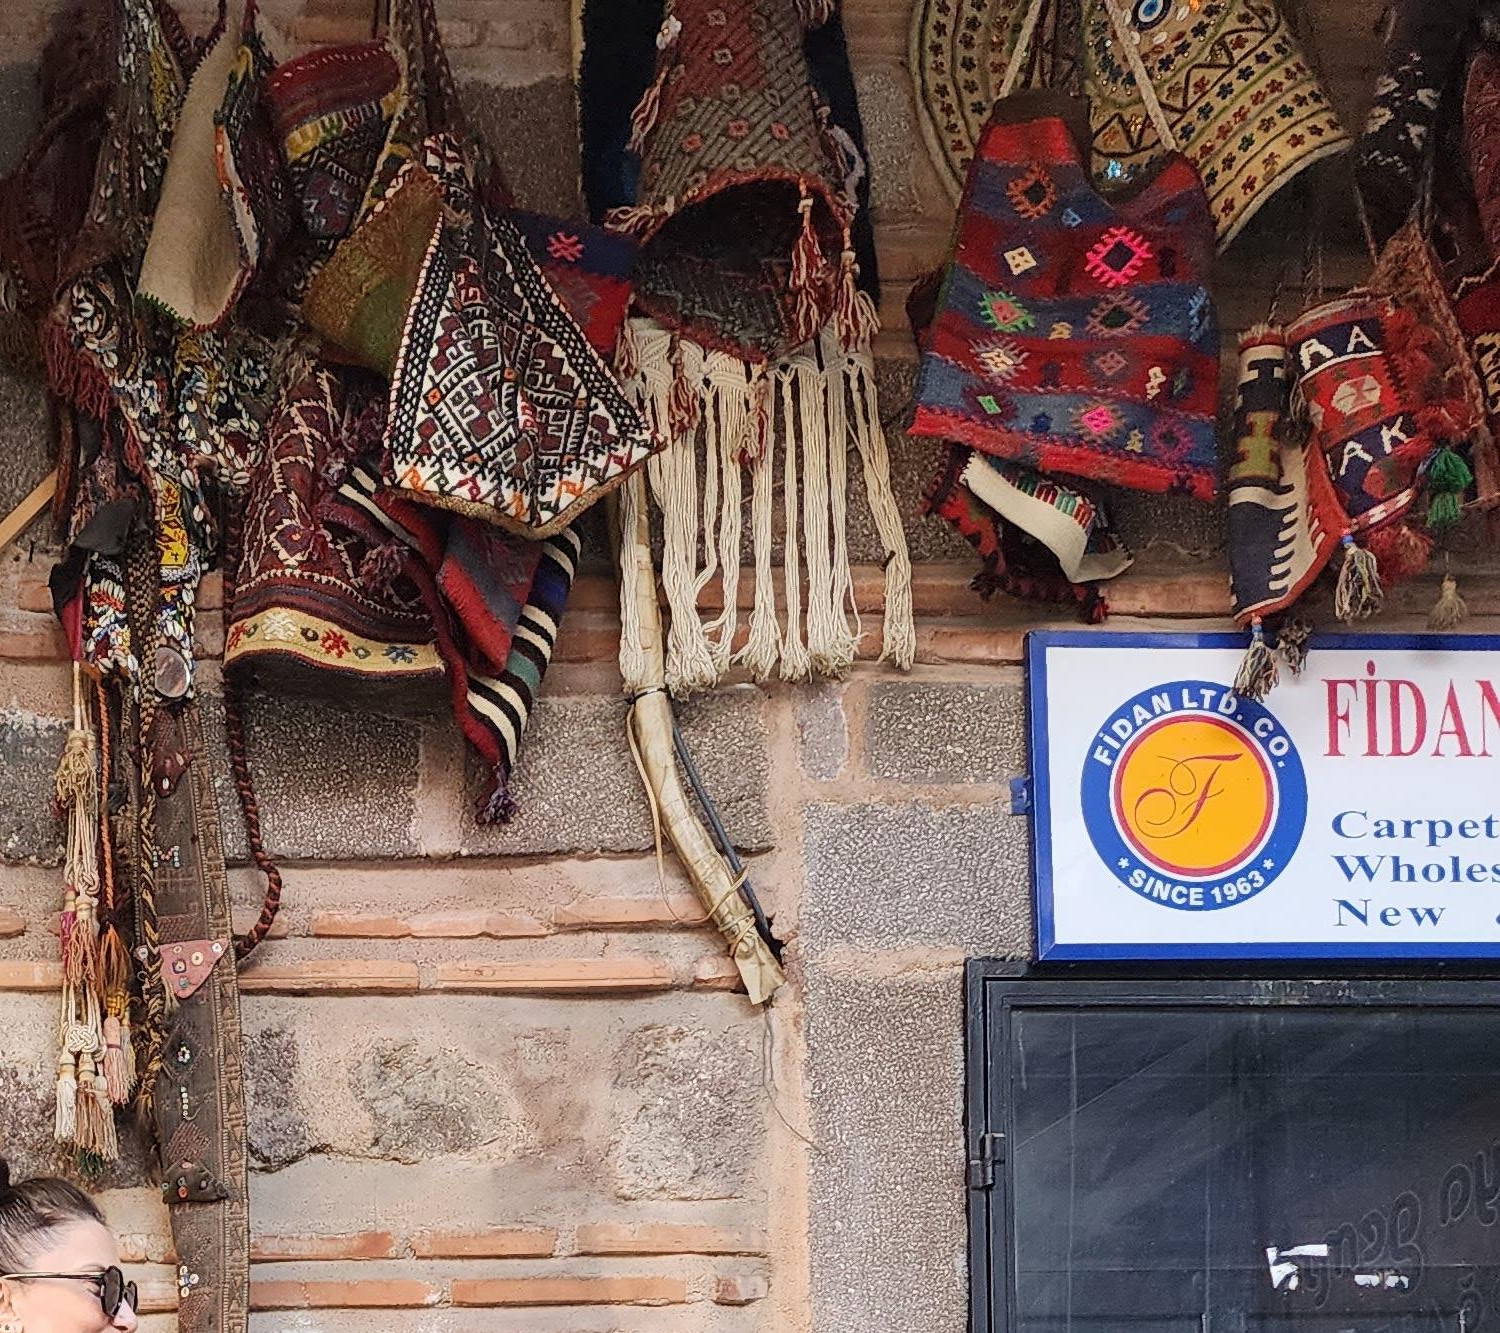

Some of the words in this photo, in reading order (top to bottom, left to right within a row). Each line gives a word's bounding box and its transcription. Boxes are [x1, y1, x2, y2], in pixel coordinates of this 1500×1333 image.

[1093, 691, 1173, 767] FİDAN
[1181, 688, 1243, 721] LTD.
[1253, 716, 1290, 768] CO.
[1331, 810, 1500, 847] Carpet
[1128, 868, 1204, 906] SINCE
[1210, 869, 1266, 904] 1963
[1331, 898, 1447, 927] New
